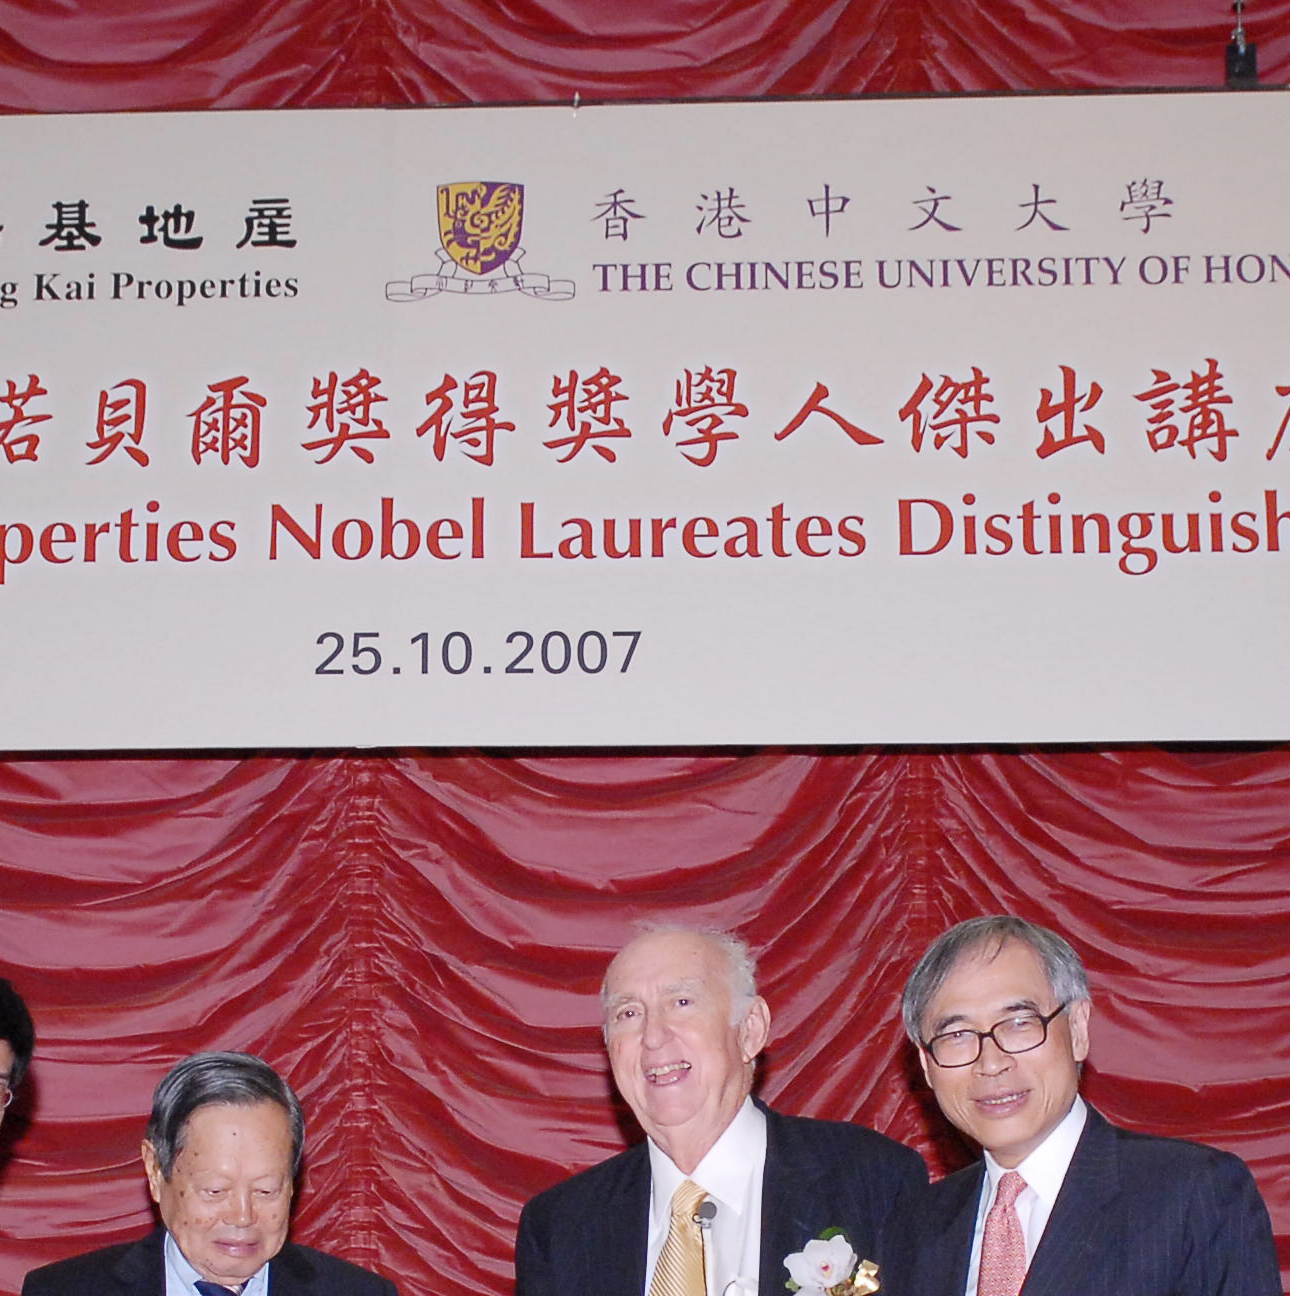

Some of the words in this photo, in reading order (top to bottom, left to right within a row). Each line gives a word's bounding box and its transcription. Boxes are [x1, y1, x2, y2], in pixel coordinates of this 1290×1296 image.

[593, 178, 1173, 241] 香港中文大學
[34, 273, 95, 300] Kai
[111, 270, 298, 306] Properties
[593, 263, 673, 292] THE
[686, 260, 863, 291] CHINESE
[876, 256, 1126, 288] UNIVERSITY
[1139, 256, 1190, 285] OF
[269, 497, 484, 560] Nobel
[520, 502, 866, 559] Laureates
[315, 631, 642, 675] 25.10.2007
